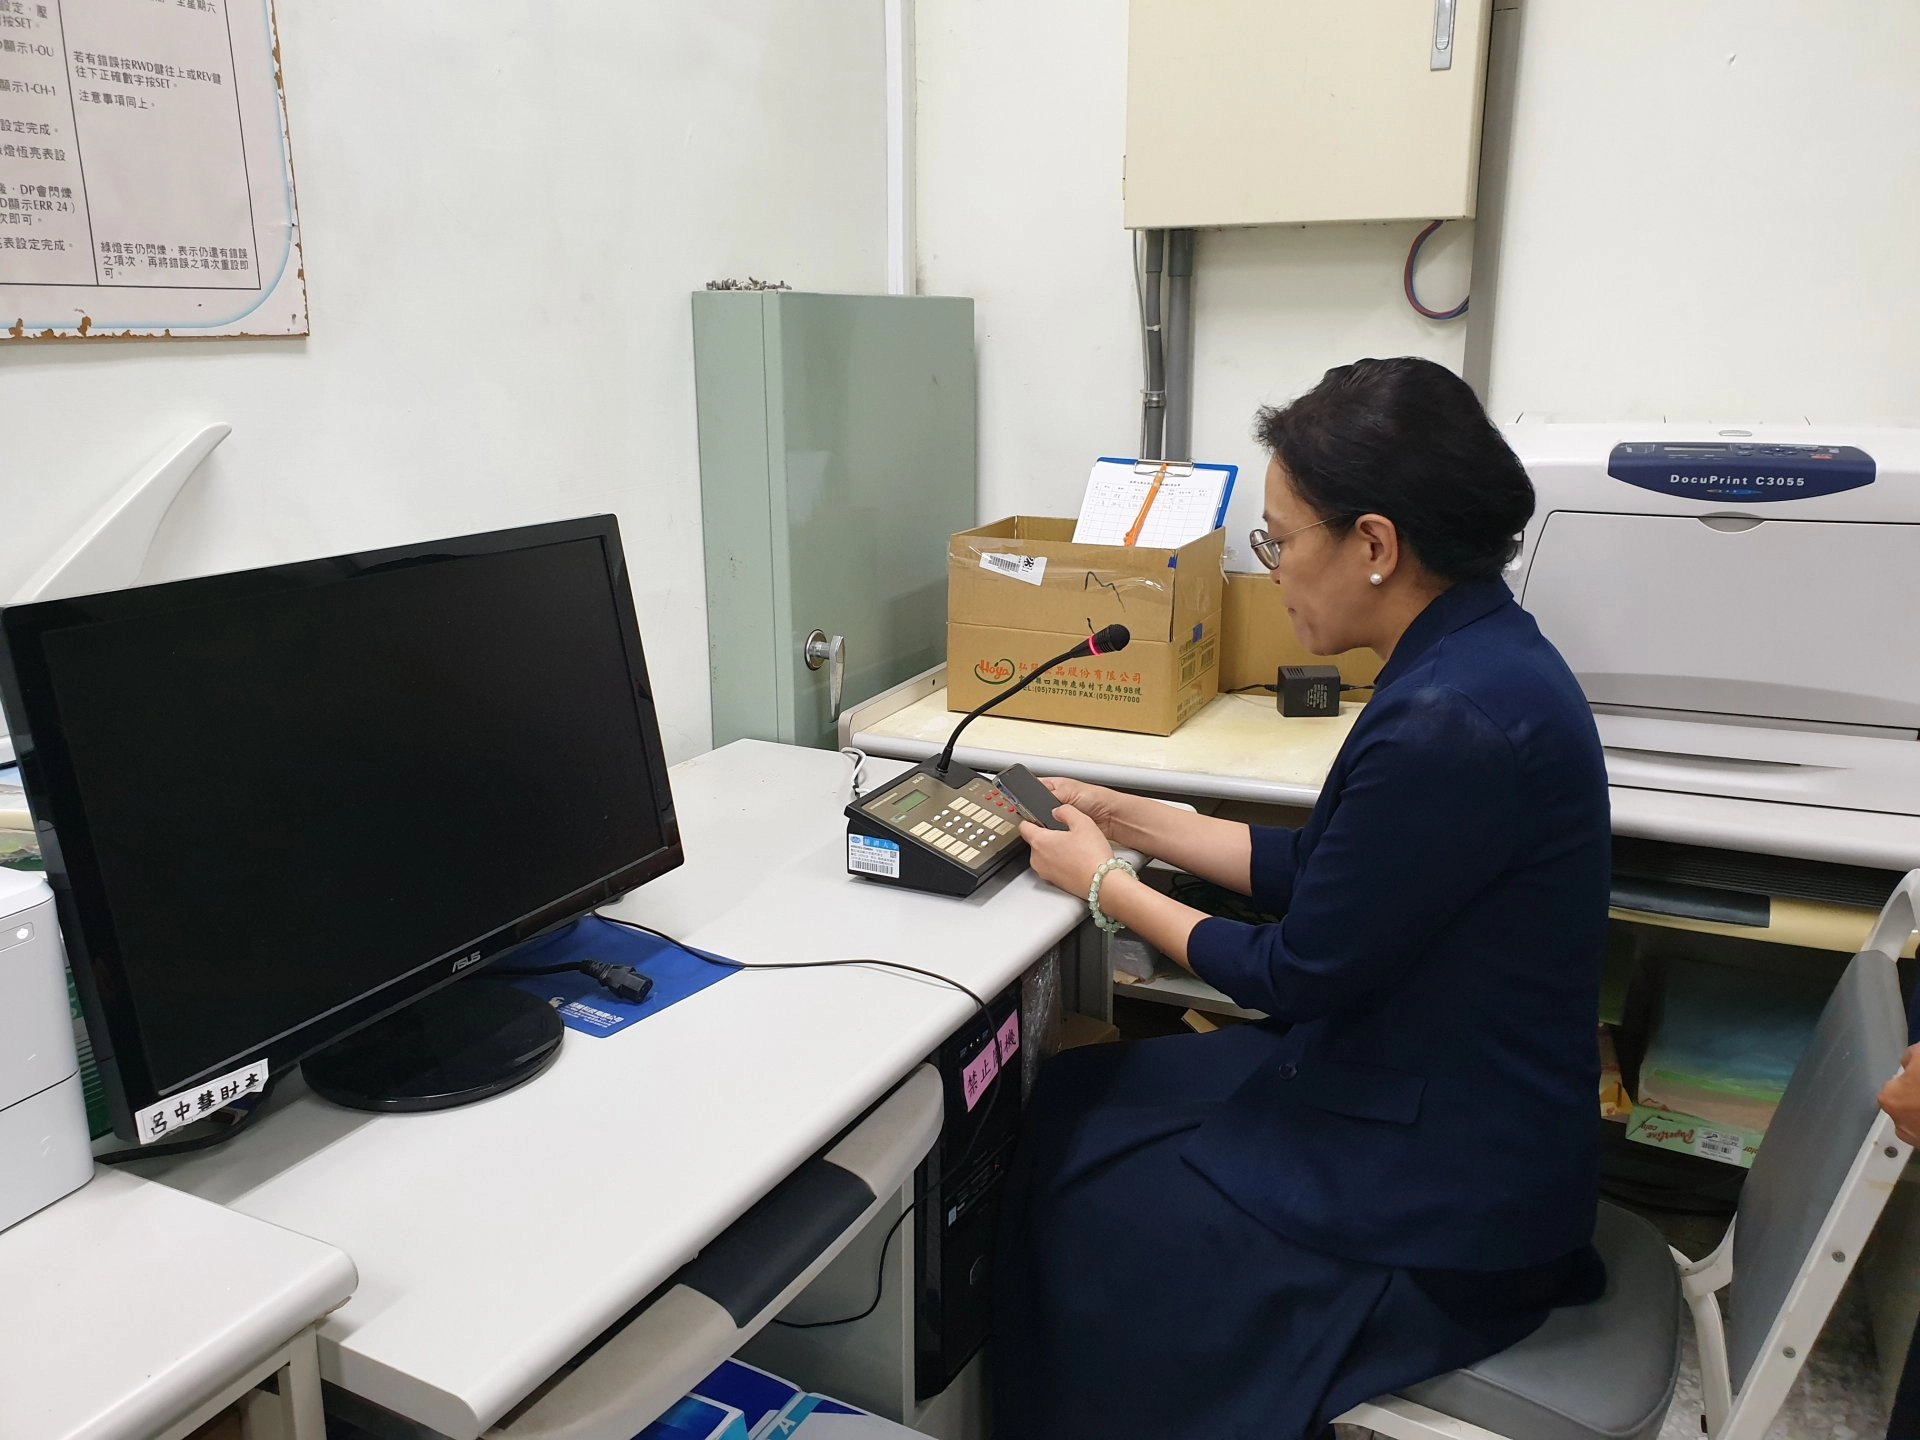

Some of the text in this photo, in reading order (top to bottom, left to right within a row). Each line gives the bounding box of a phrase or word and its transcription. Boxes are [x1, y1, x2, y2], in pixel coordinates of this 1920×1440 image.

[1670, 474, 1805, 486] DocuPrint C3055
[979, 659, 1010, 679] Hoya
[452, 950, 481, 973] ASUS
